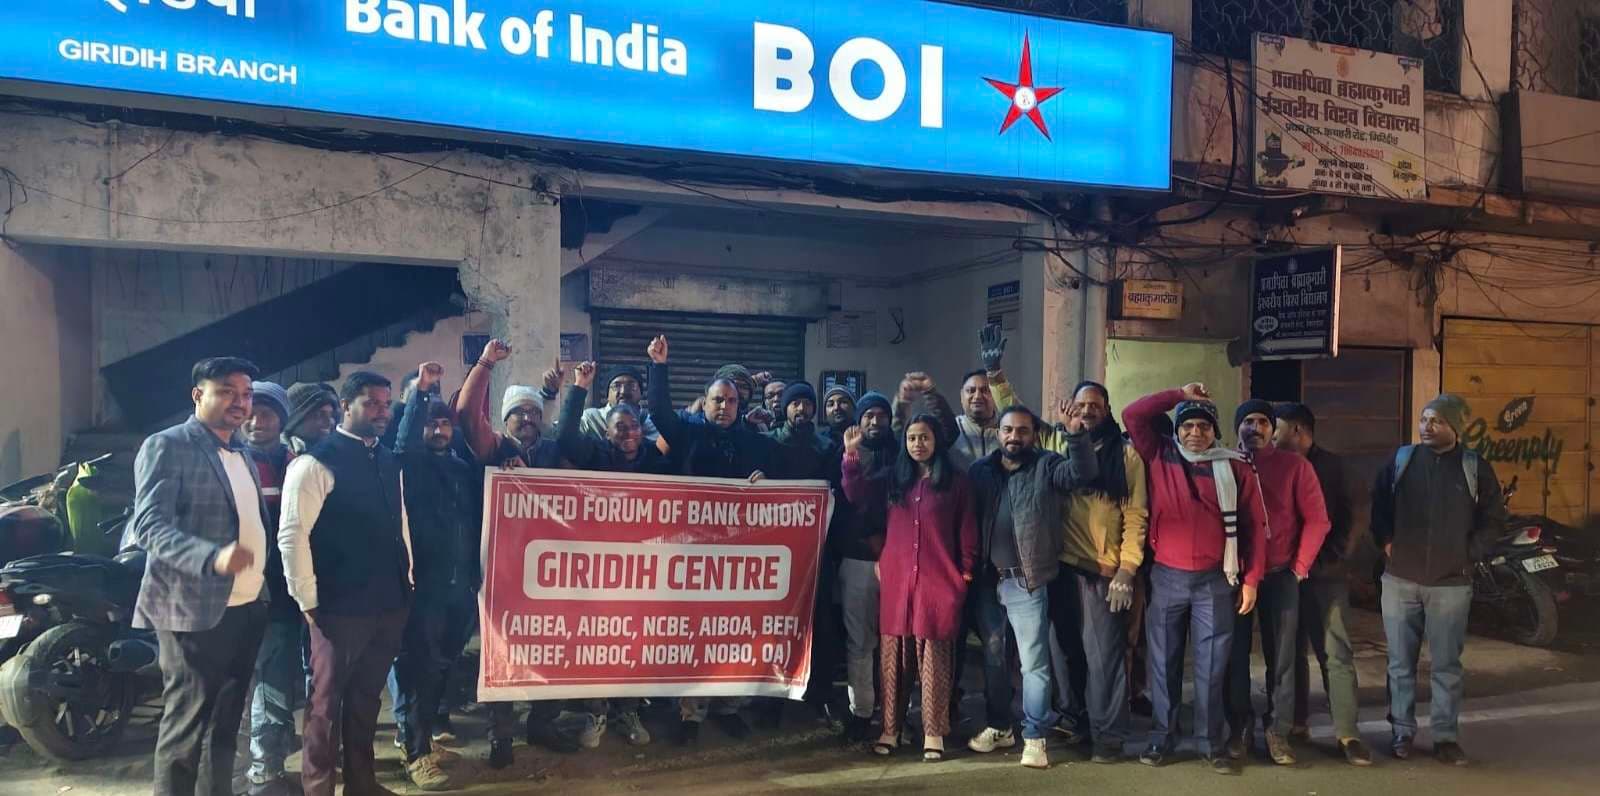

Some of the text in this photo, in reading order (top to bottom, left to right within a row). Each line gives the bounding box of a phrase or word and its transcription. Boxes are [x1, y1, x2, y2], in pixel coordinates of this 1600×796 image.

[346, 0, 687, 76] Bank of India
[58, 39, 297, 85] GIRIDIH BRANCH
[754, 21, 943, 128] BOI
[1272, 69, 1332, 96] प्रजापिता
[1363, 105, 1420, 134] विद्यालय
[504, 493, 816, 528] UNITED FORUM OF BANK UNIONS
[537, 551, 780, 591] GIRIDIH CENTRE
[502, 611, 803, 641] (AIBEA, AIBOC, NCBE, AIBOA, BEFI,
[509, 643, 791, 668] INBEF, INBOC, NOBW, NOBO, OA)
